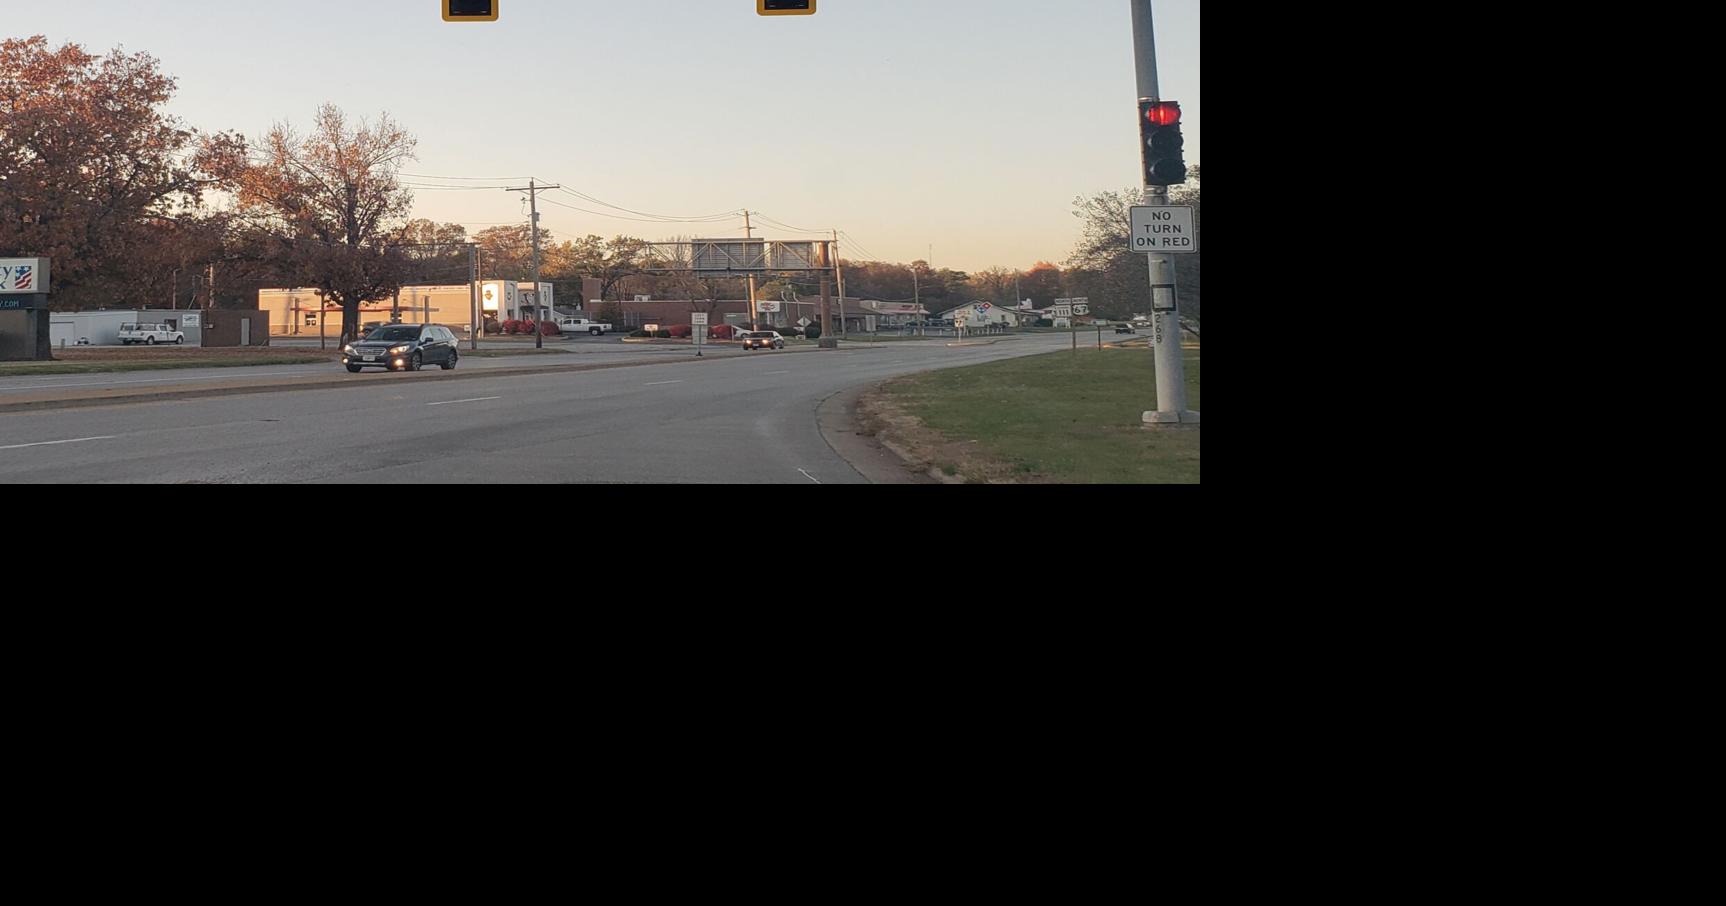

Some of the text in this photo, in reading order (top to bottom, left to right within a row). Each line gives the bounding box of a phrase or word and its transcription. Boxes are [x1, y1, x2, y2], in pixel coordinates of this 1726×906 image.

[1152, 211, 1171, 221] NO
[1144, 224, 1182, 233] TURN
[1136, 237, 1190, 246] ON RED
